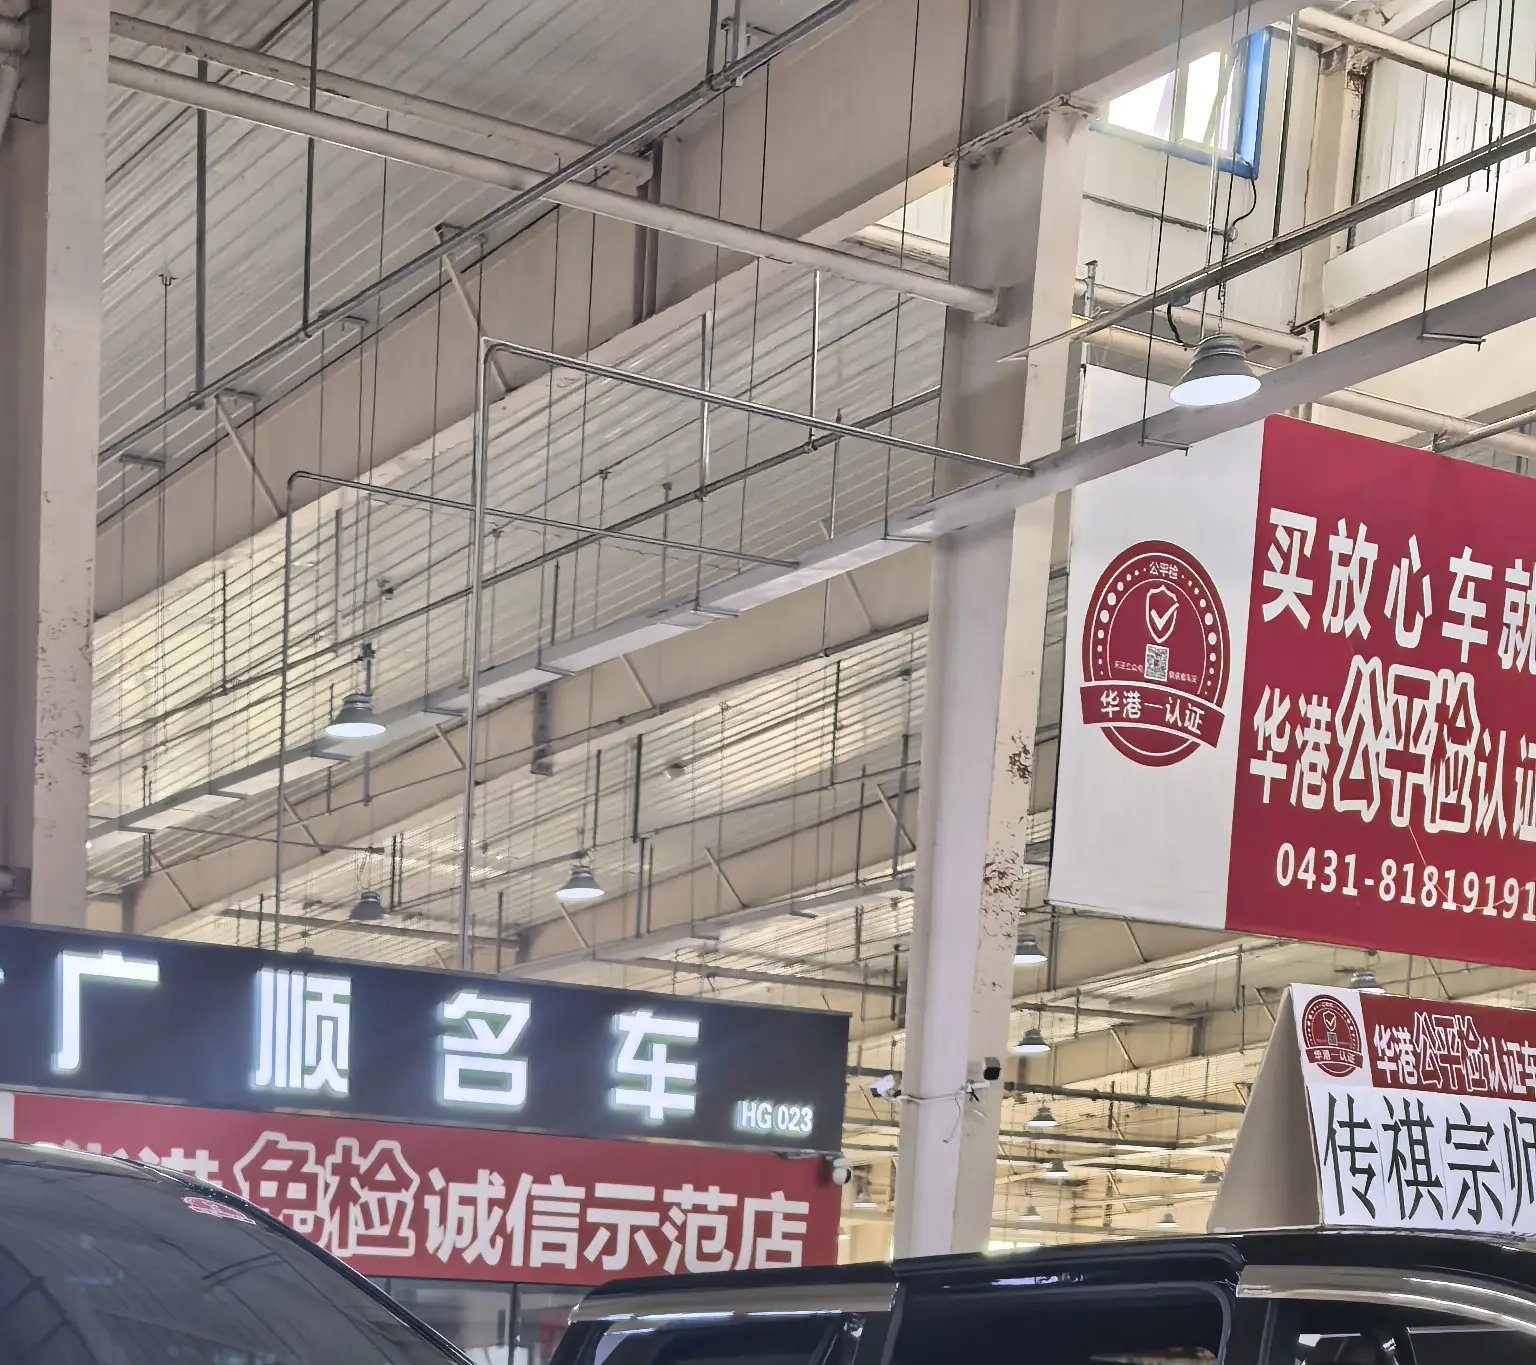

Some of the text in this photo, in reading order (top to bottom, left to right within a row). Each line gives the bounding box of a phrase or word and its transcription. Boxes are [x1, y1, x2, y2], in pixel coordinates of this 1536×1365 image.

[52, 950, 702, 1122] 广顺名车
[736, 1101, 815, 1132] HG 023
[64, 1131, 811, 1275] 免检诚信示范店
